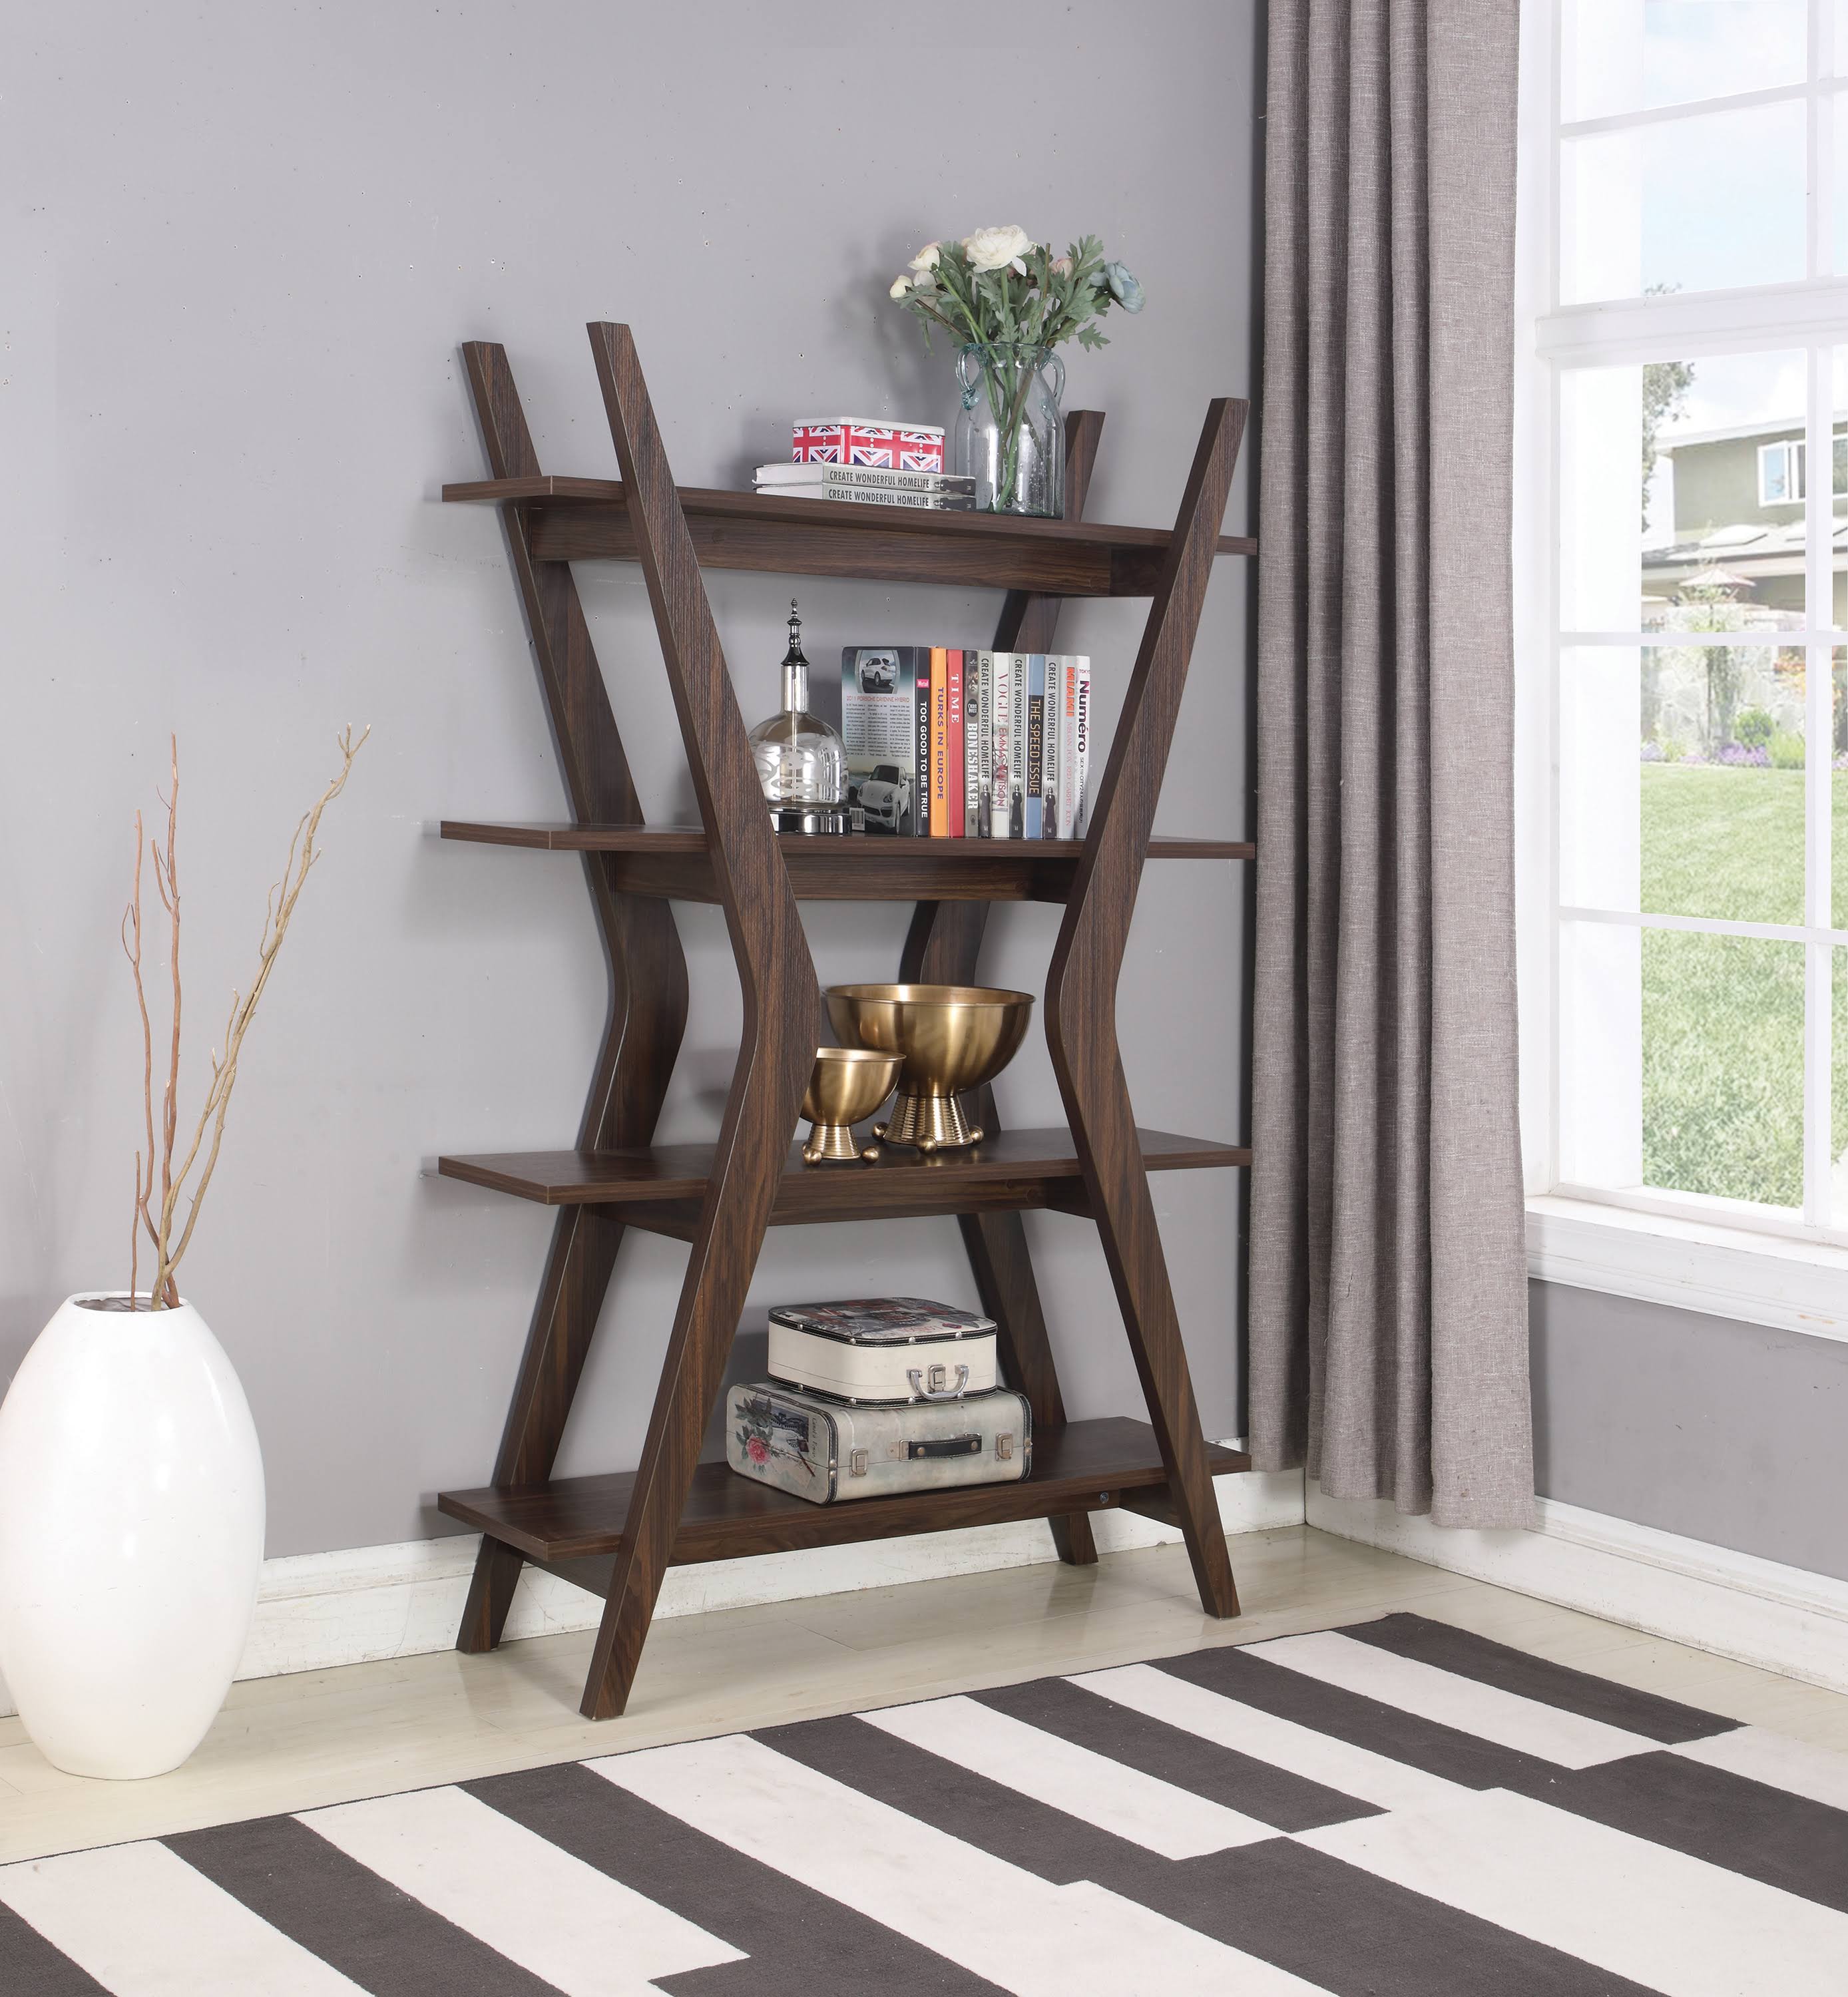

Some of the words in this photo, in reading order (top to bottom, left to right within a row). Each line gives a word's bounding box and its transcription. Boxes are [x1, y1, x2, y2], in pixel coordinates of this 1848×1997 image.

[829, 471, 853, 482] CREATE
[855, 473, 896, 485] WONDERFUL
[898, 476, 929, 489] HOMELIFE
[828, 489, 853, 500] CREATE
[855, 491, 895, 504] WONDERFUL
[897, 495, 929, 507] HOMELIFE
[997, 672, 1009, 723] VOGUE
[1030, 700, 1040, 720] THE
[1047, 692, 1056, 740] WONDERFUL
[1078, 680, 1089, 753] Numéro
[938, 732, 943, 746] IN
[999, 728, 1007, 758] EMMA
[1029, 724, 1040, 758] SPEED
[920, 758, 927, 772] TO
[967, 723, 978, 809] BONESHAKER
[1029, 761, 1040, 794] ISSUE
[1046, 744, 1055, 781] HOMELIFE
[921, 775, 927, 788] BE
[997, 764, 1007, 807] WATSON
